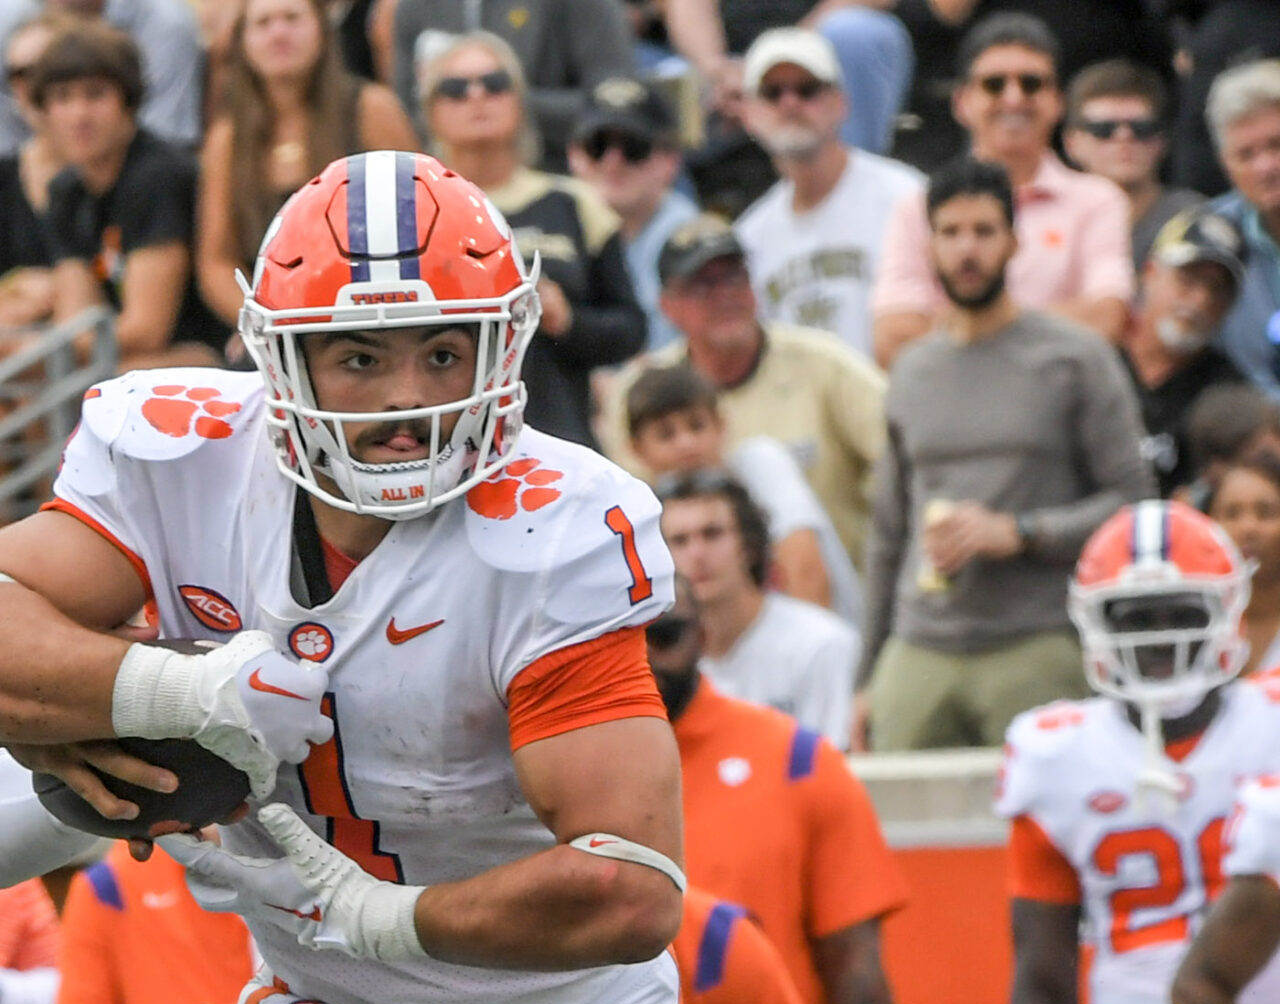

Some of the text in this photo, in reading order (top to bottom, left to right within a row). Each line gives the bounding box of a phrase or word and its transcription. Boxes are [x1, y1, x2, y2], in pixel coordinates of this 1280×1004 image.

[350, 290, 418, 306] TIGERS
[381, 485, 425, 502] ALL IN
[604, 505, 653, 607] 1
[184, 594, 238, 624] ACC
[297, 691, 406, 886] 1
